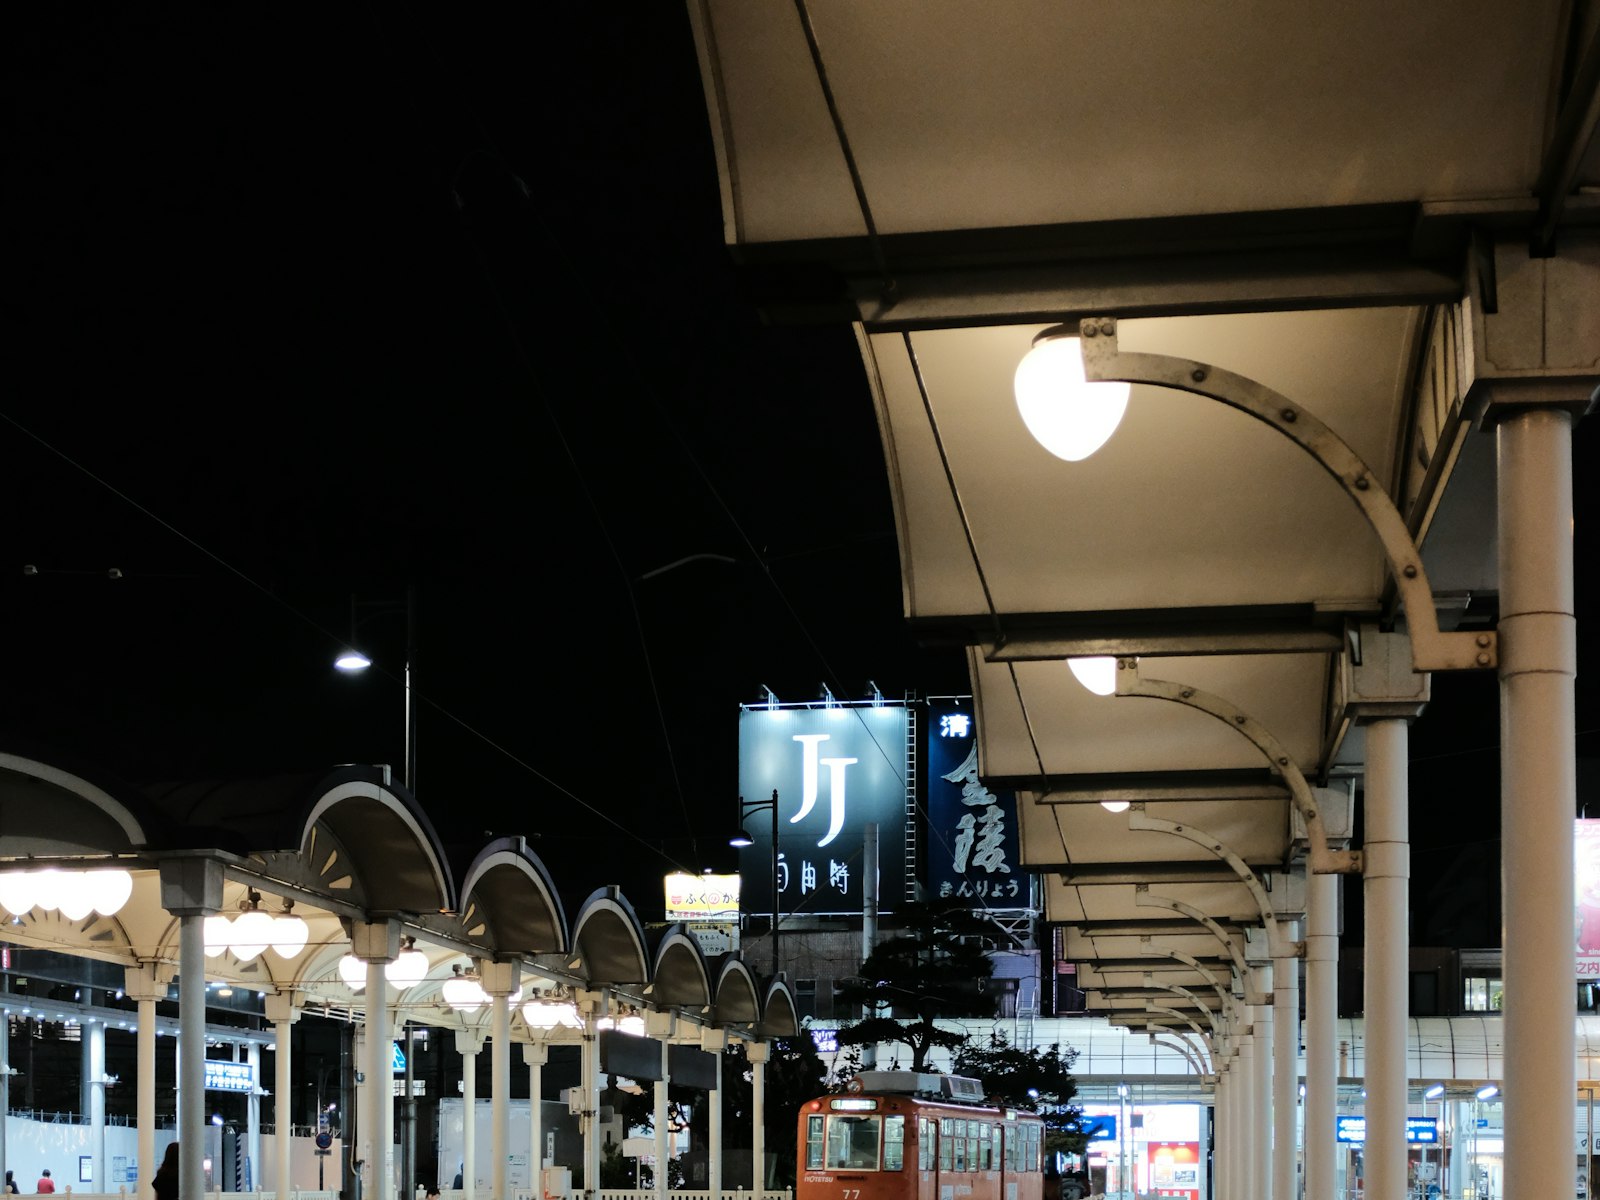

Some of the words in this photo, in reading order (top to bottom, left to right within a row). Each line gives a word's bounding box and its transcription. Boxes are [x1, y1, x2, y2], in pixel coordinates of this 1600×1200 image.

[790, 733, 858, 848] JJ
[939, 878, 1019, 898] きんりょう
[842, 1189, 860, 1200] 77
